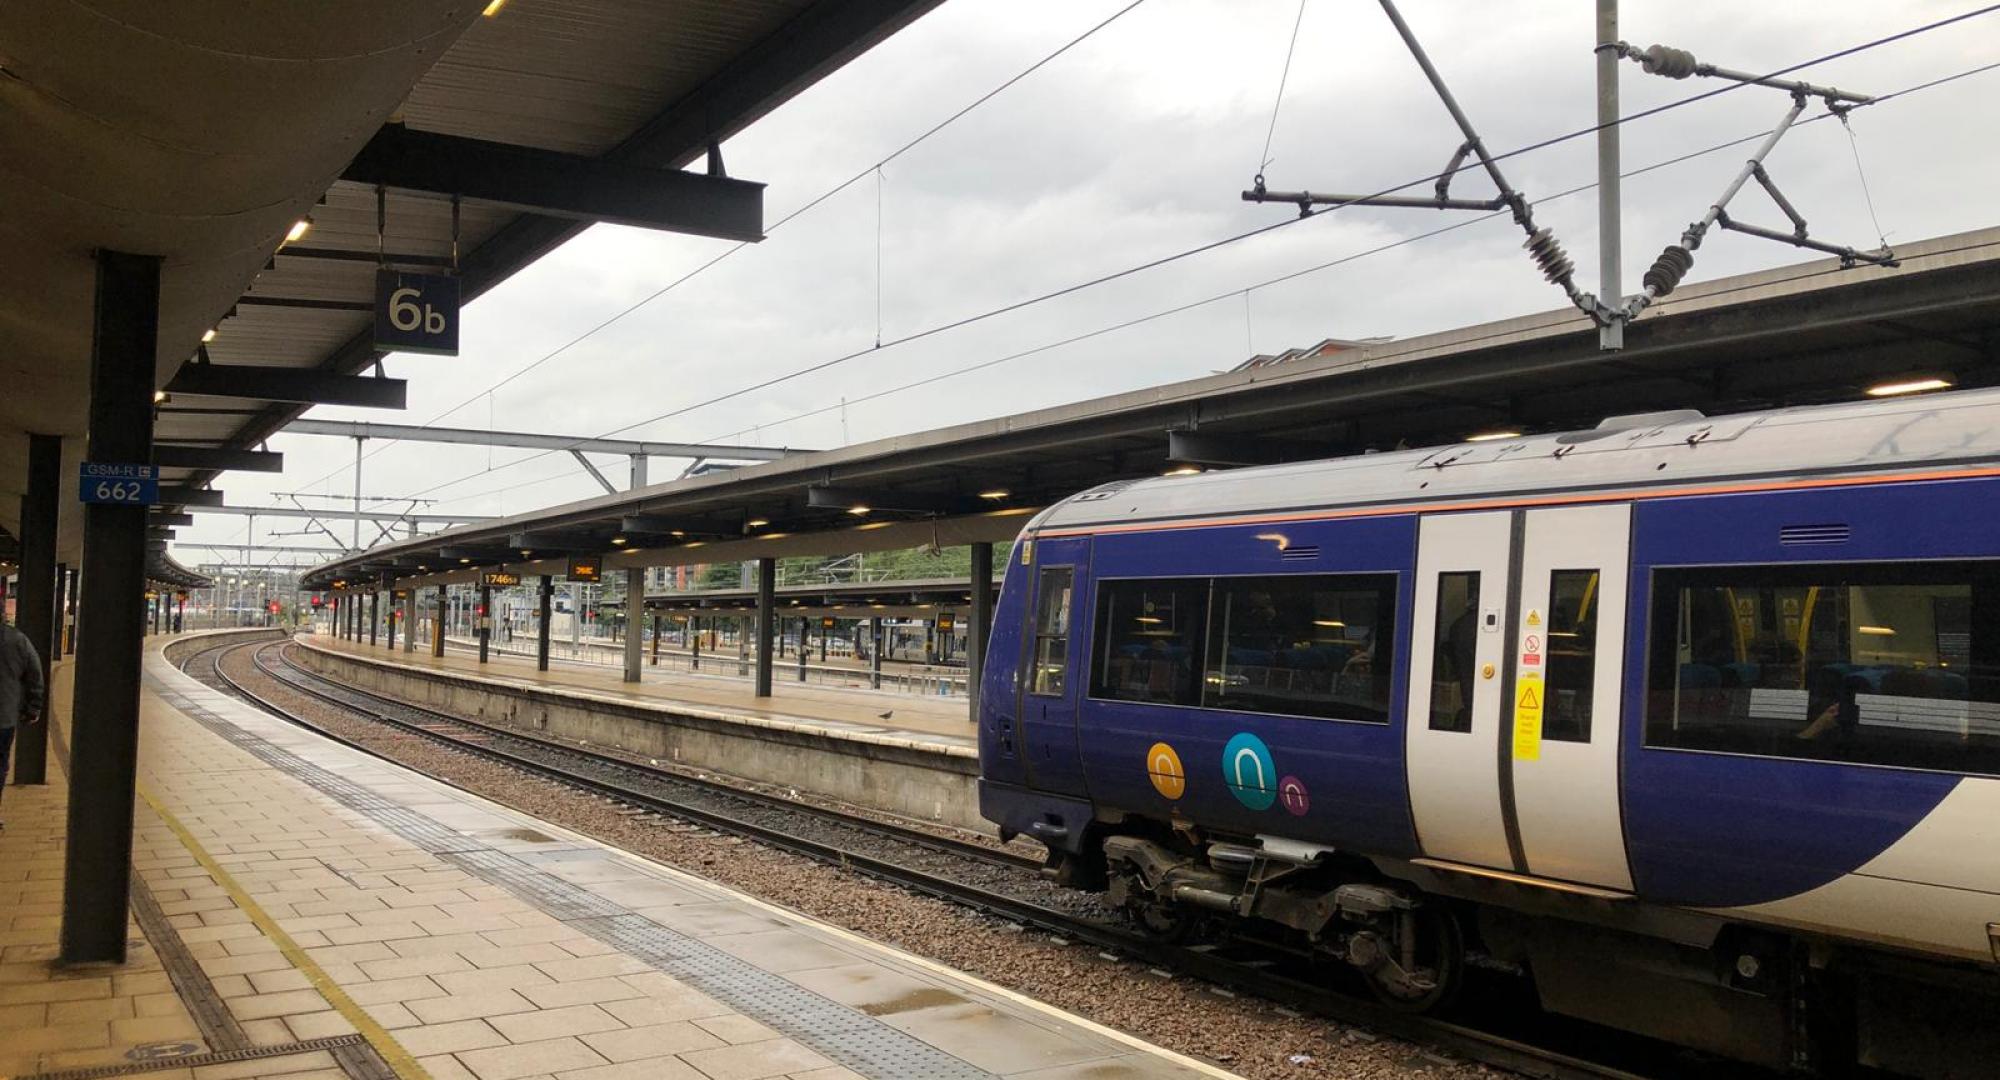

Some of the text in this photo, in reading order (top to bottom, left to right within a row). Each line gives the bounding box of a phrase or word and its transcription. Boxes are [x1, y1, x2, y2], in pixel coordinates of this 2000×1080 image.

[389, 288, 446, 334] 6b
[88, 464, 134, 476] GSM-R
[96, 481, 141, 501] 662
